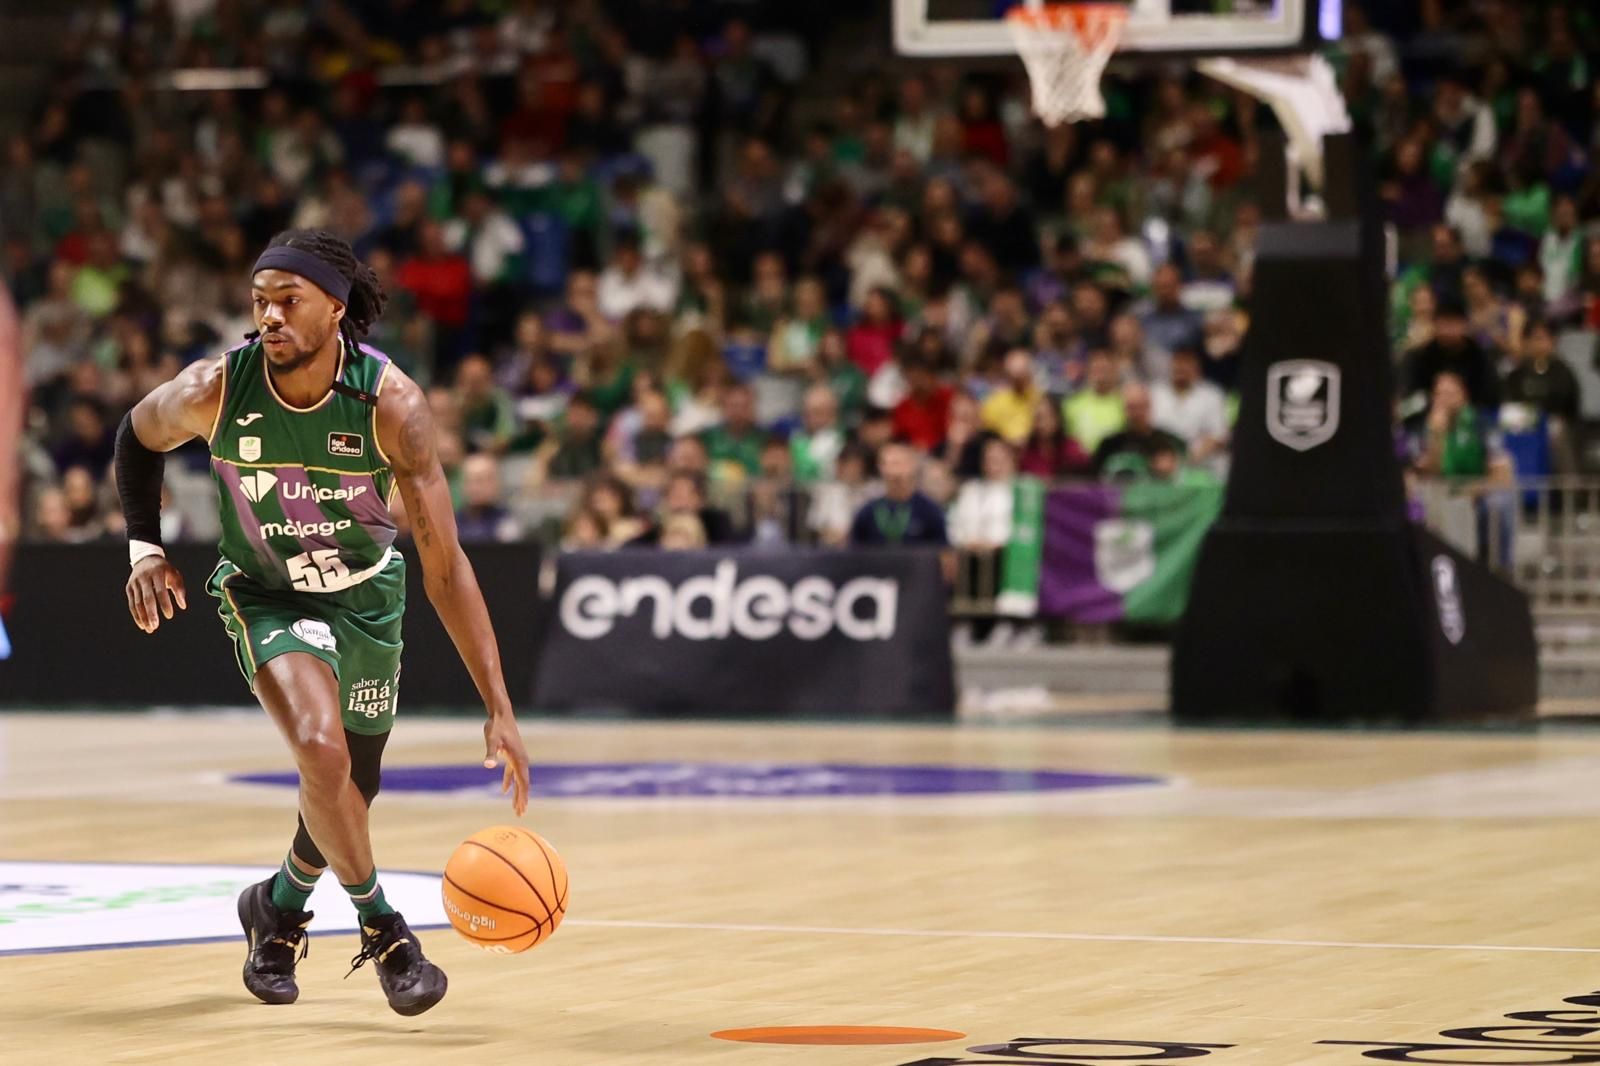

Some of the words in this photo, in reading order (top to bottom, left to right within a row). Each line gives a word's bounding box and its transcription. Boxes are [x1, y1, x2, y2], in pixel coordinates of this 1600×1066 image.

[282, 482, 368, 503] Unicaja
[285, 549, 351, 592] 55
[560, 558, 899, 641] endesa
[351, 678, 380, 690] sabor
